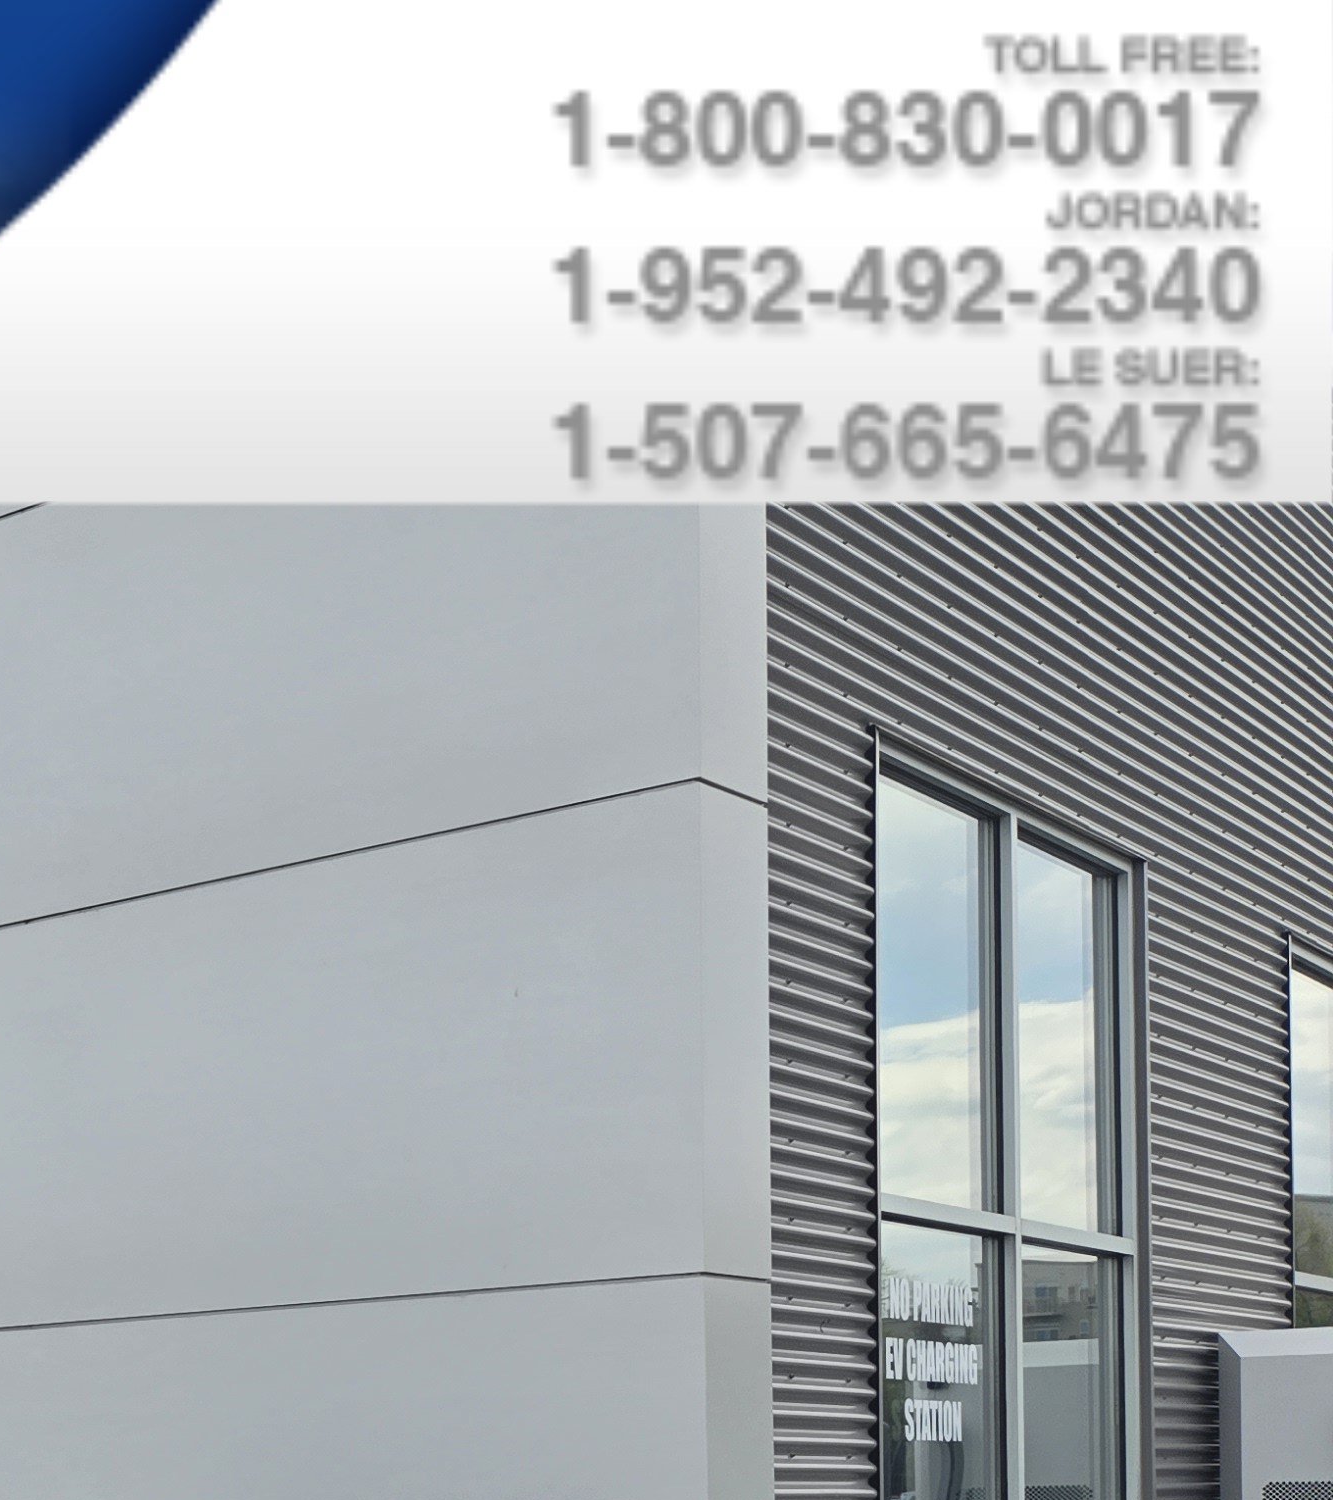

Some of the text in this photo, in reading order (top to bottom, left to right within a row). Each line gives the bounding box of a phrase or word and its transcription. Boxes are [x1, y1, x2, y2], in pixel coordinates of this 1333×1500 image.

[888, 1276, 974, 1327] NO PARKING
[885, 1336, 978, 1385] EV CHARGING
[904, 1397, 963, 1442] STATION
